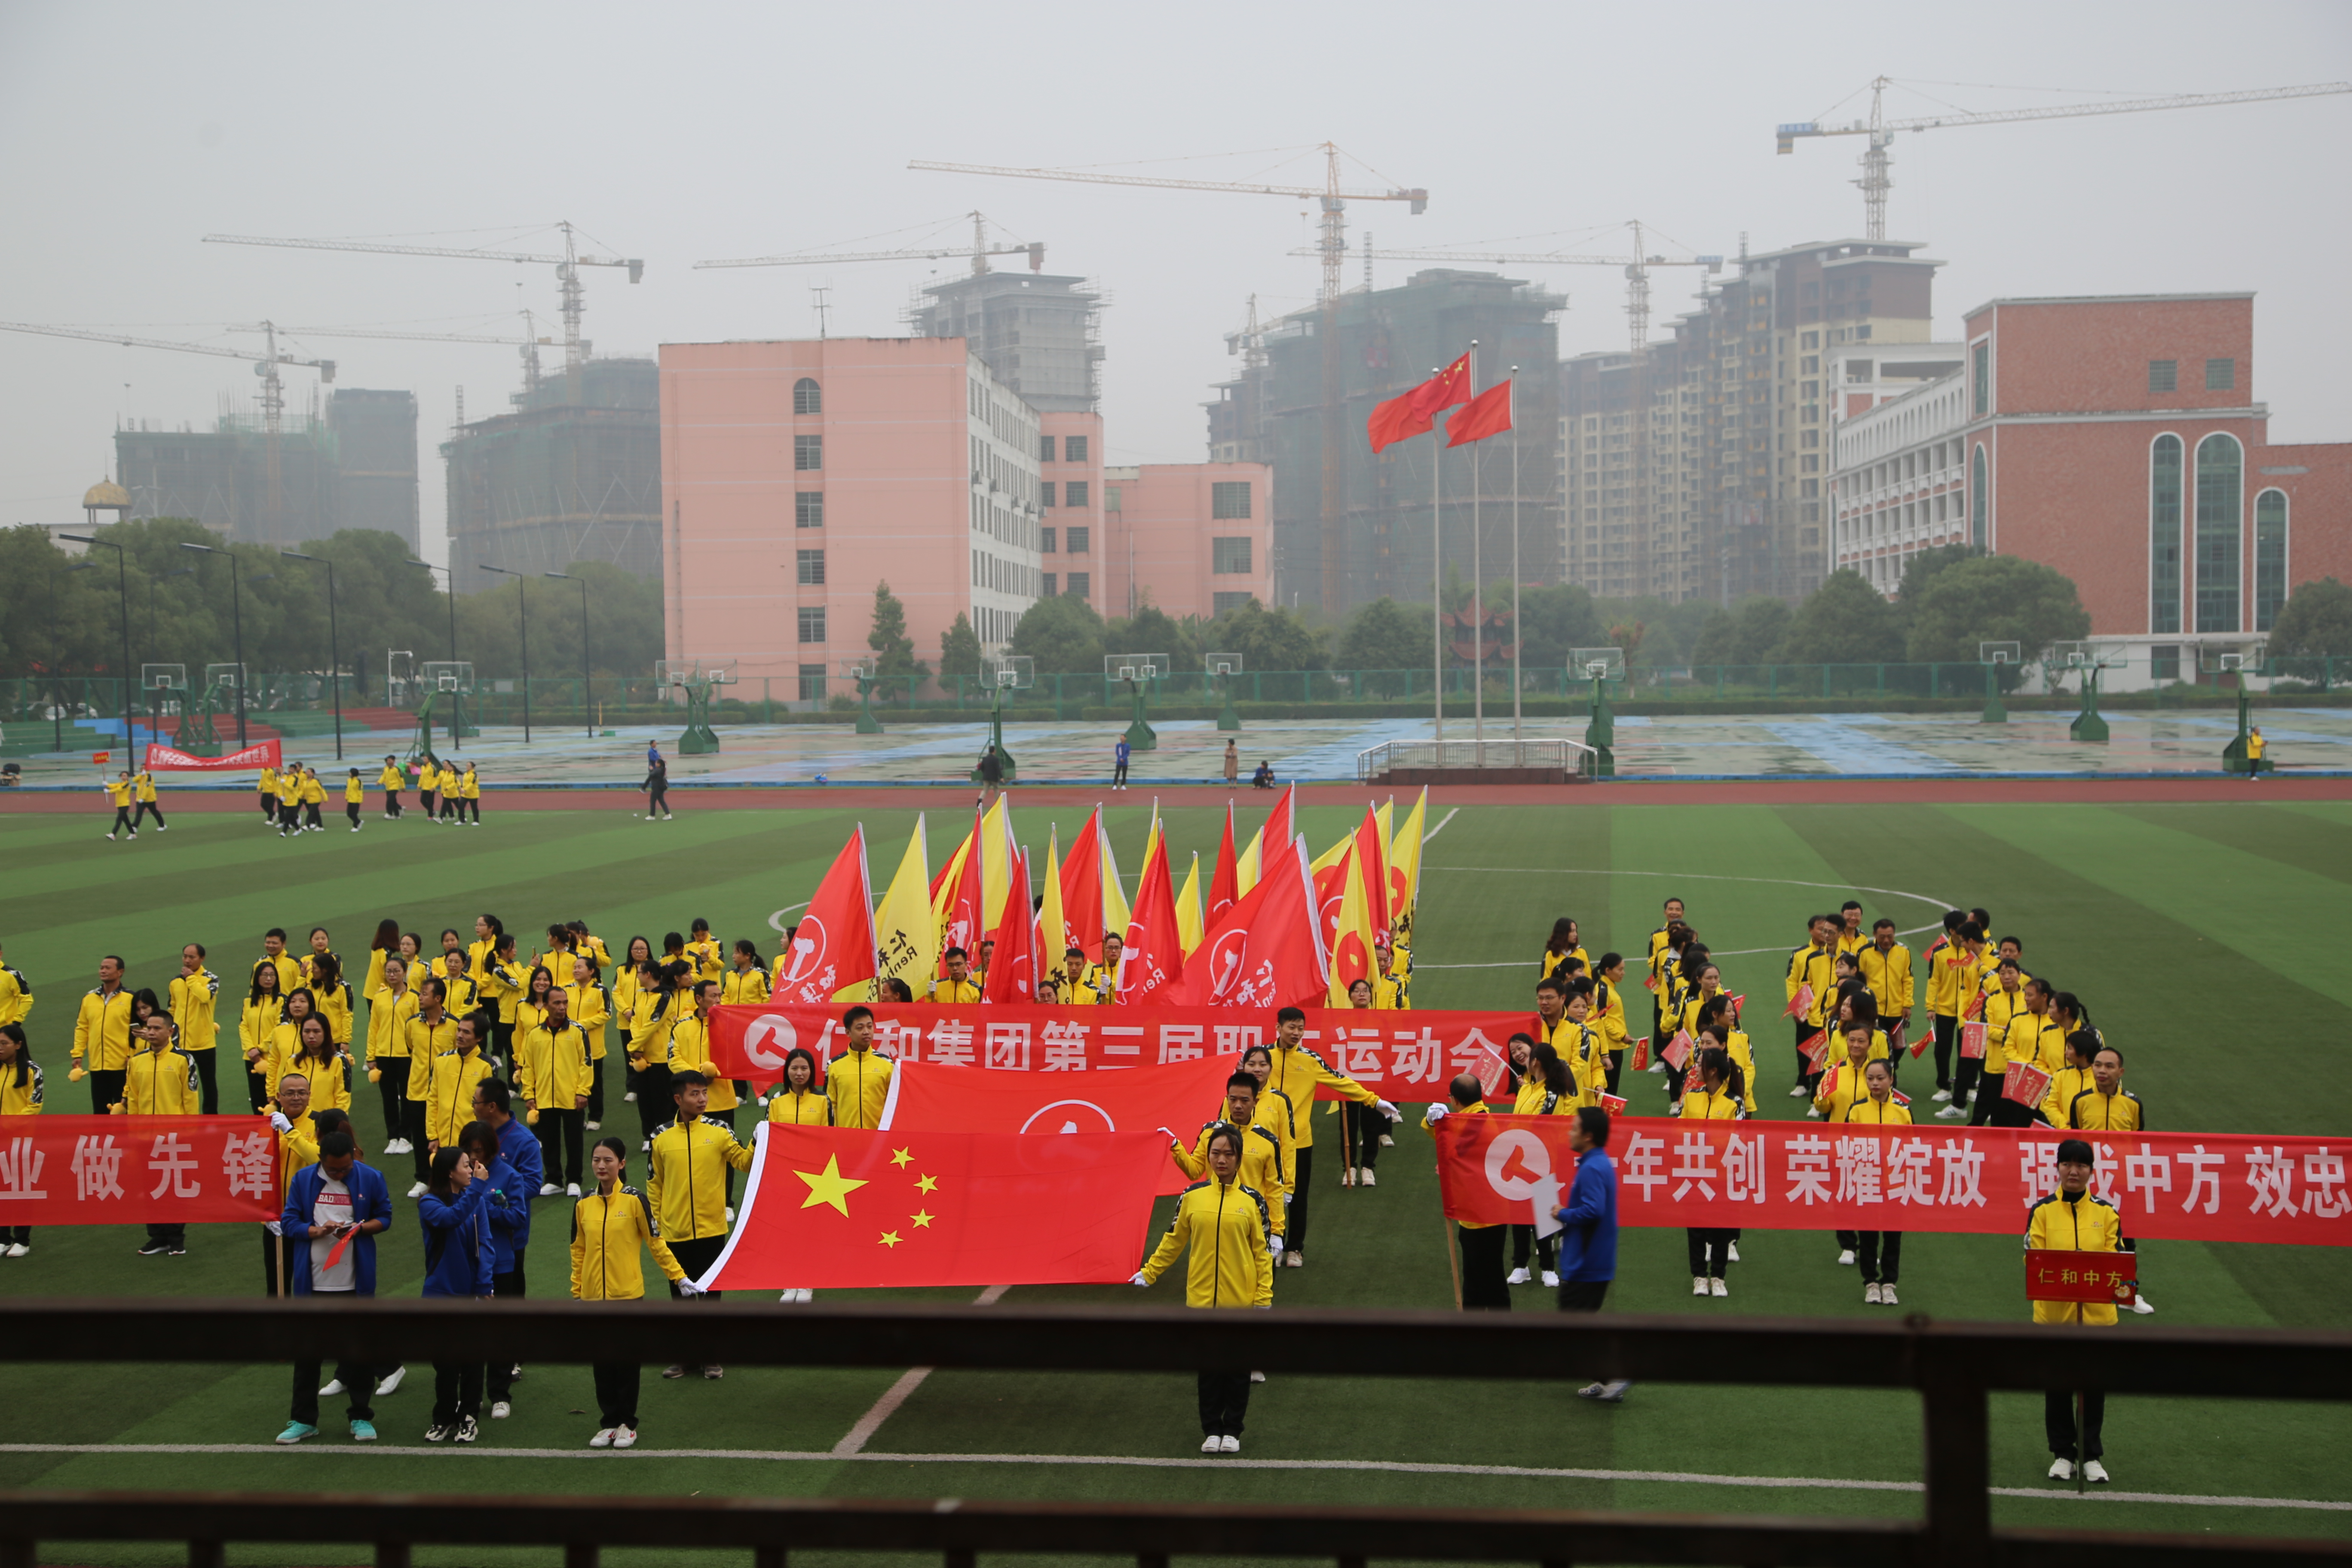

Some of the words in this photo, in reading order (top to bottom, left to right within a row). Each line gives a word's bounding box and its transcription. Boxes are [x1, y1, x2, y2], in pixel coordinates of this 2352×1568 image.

[815, 1018, 1503, 1084] 仁和集团第三届职运动会
[1785, 1134, 1987, 1208] 荣耀绽放
[2245, 1146, 2352, 1218] 效忠
[2038, 1268, 2122, 1288] 仁和中方
